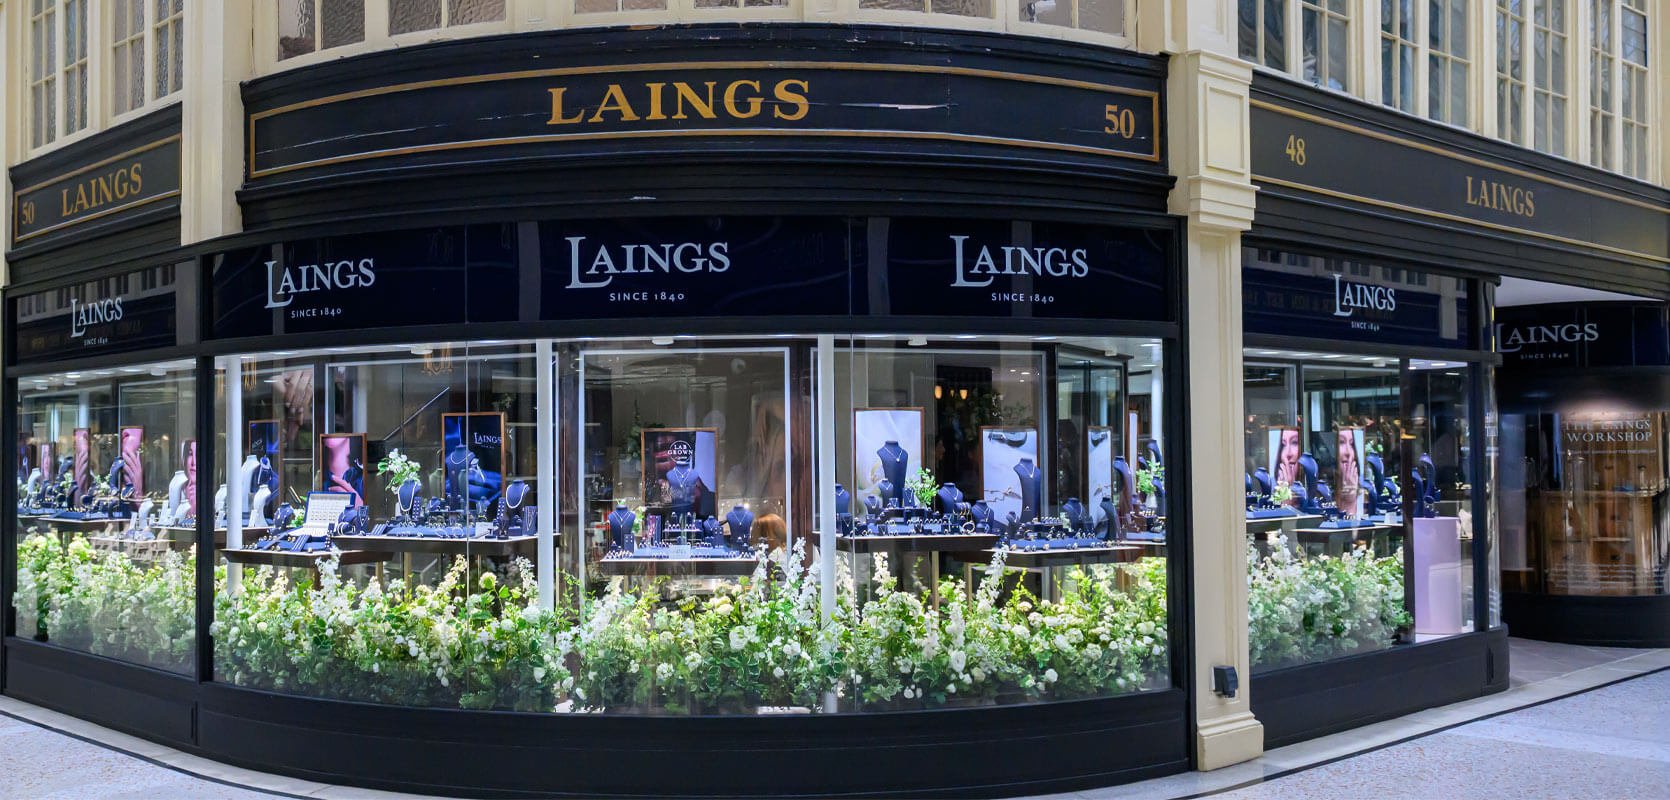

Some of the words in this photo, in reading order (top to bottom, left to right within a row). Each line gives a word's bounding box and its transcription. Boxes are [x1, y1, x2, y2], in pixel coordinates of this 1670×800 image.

[546, 79, 810, 126] LAINGS
[1104, 104, 1135, 139] 50
[1285, 134, 1306, 166] 48
[22, 201, 35, 225] 50
[62, 163, 143, 217] LAINGS
[1465, 176, 1535, 218] LAINGS
[564, 236, 730, 289] LAINGS
[949, 235, 1089, 287] LAINGS
[263, 258, 376, 309] LAINGS
[609, 292, 649, 301] SINCE
[654, 292, 685, 302] 1840
[991, 292, 1025, 302] SINCE
[1029, 294, 1055, 305] 1840
[1332, 273, 1396, 316] LAINGS
[70, 297, 123, 338] LAINGS
[291, 308, 317, 319] SINCE
[320, 307, 342, 317] 1840
[1351, 321, 1367, 330] SINCE
[84, 338, 97, 346] SINCE
[1496, 323, 1599, 353] LAINGS
[1567, 431, 1652, 442] WORKSHOP
